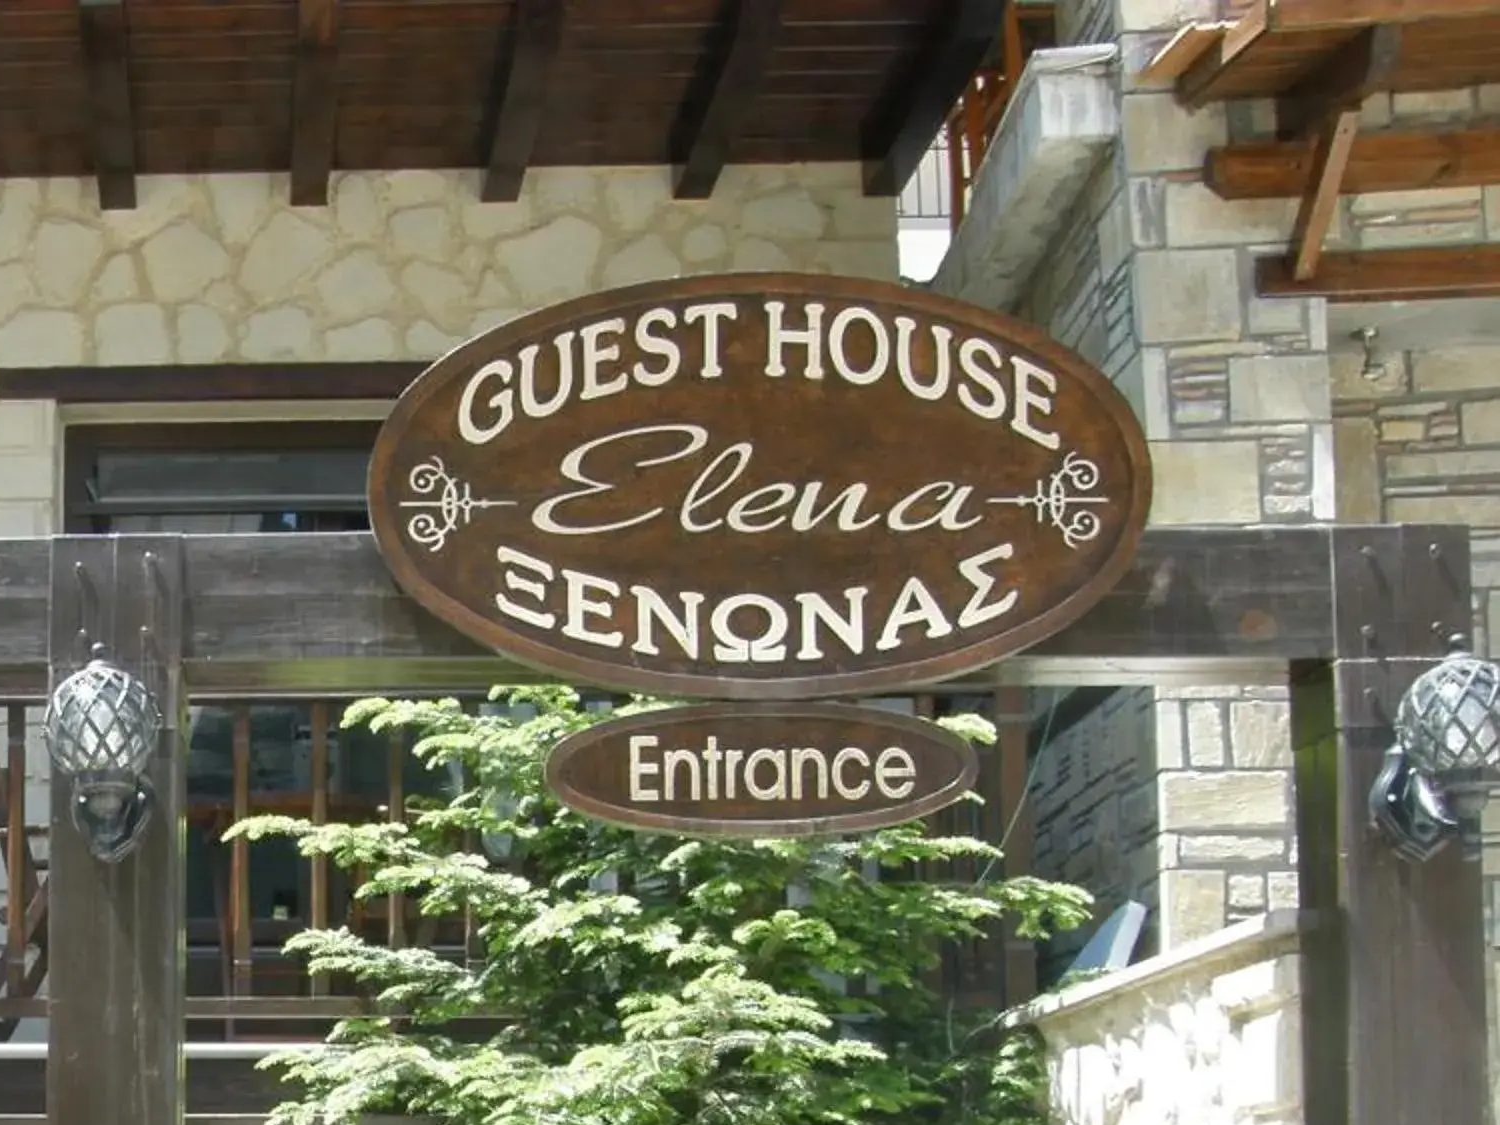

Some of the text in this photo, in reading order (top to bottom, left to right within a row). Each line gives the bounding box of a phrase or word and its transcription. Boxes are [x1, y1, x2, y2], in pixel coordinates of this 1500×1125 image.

[458, 302, 1061, 449] GUEST HOUSE
[530, 424, 984, 534] Elena
[495, 544, 1017, 662] ΞΕΝΩΝΑΣ
[629, 735, 917, 801] Entrance
